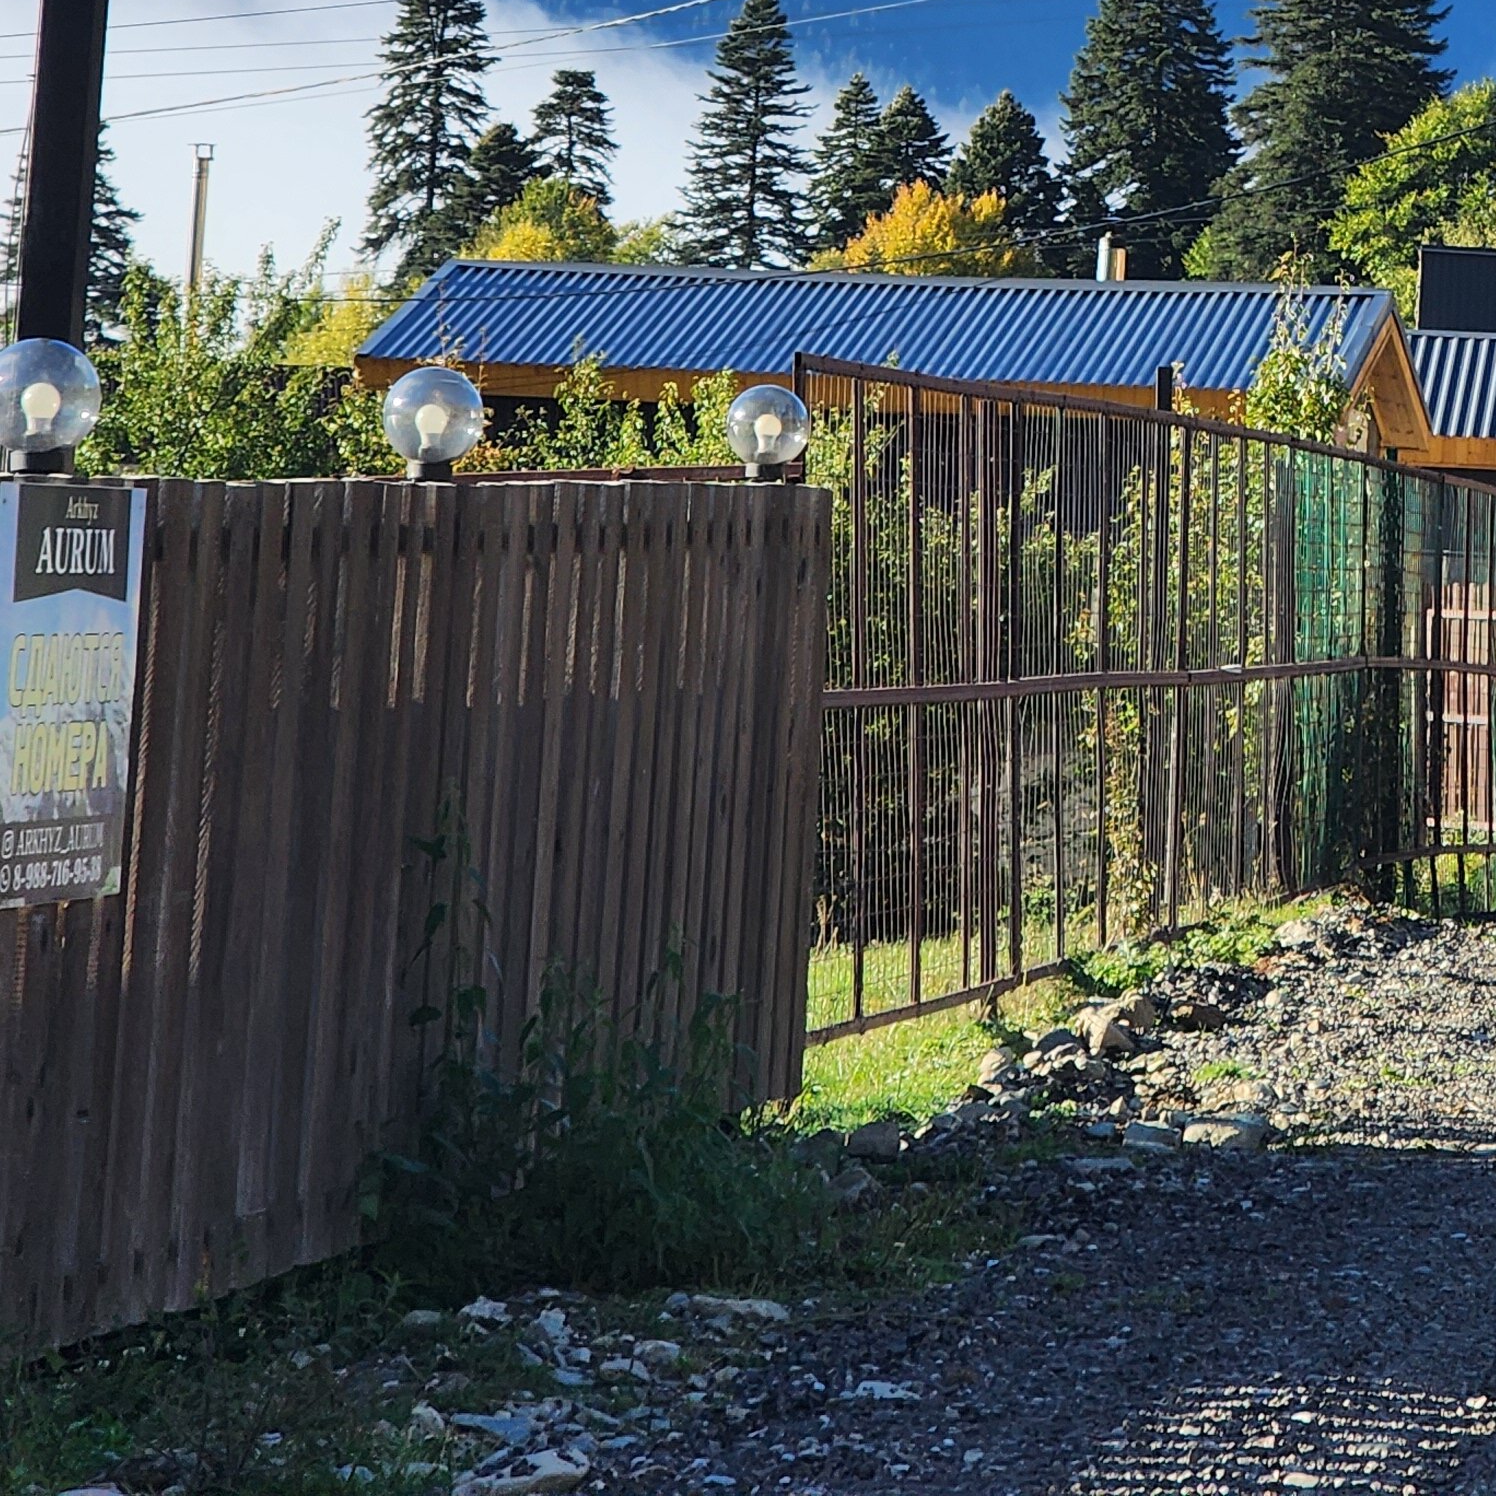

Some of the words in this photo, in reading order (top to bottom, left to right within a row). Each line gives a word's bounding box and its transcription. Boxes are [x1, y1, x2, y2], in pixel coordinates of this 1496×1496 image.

[65, 495, 100, 526] Arkhyz
[35, 526, 115, 575] AURUM
[8, 632, 124, 719] СДАЮТСЯ
[10, 719, 108, 796] НОМЕРА
